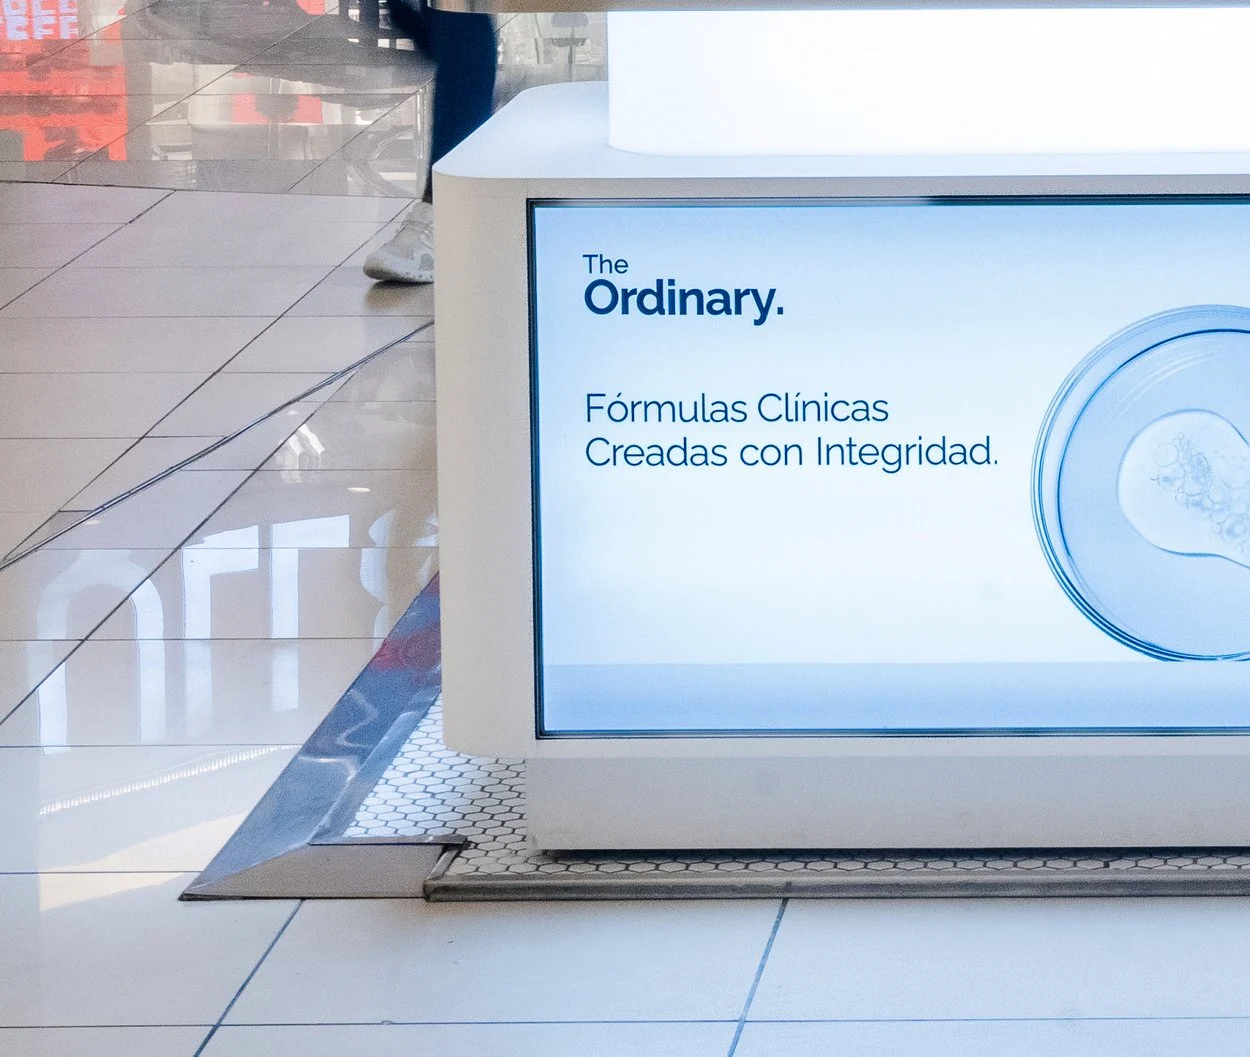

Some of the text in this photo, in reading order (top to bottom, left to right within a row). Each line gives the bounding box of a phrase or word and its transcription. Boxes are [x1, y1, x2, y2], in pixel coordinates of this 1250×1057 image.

[583, 254, 629, 274] The
[584, 278, 785, 326] Ordinary.
[586, 392, 889, 423] Fórmulas Clínicas
[585, 435, 999, 474] Creadas con Integridad.
